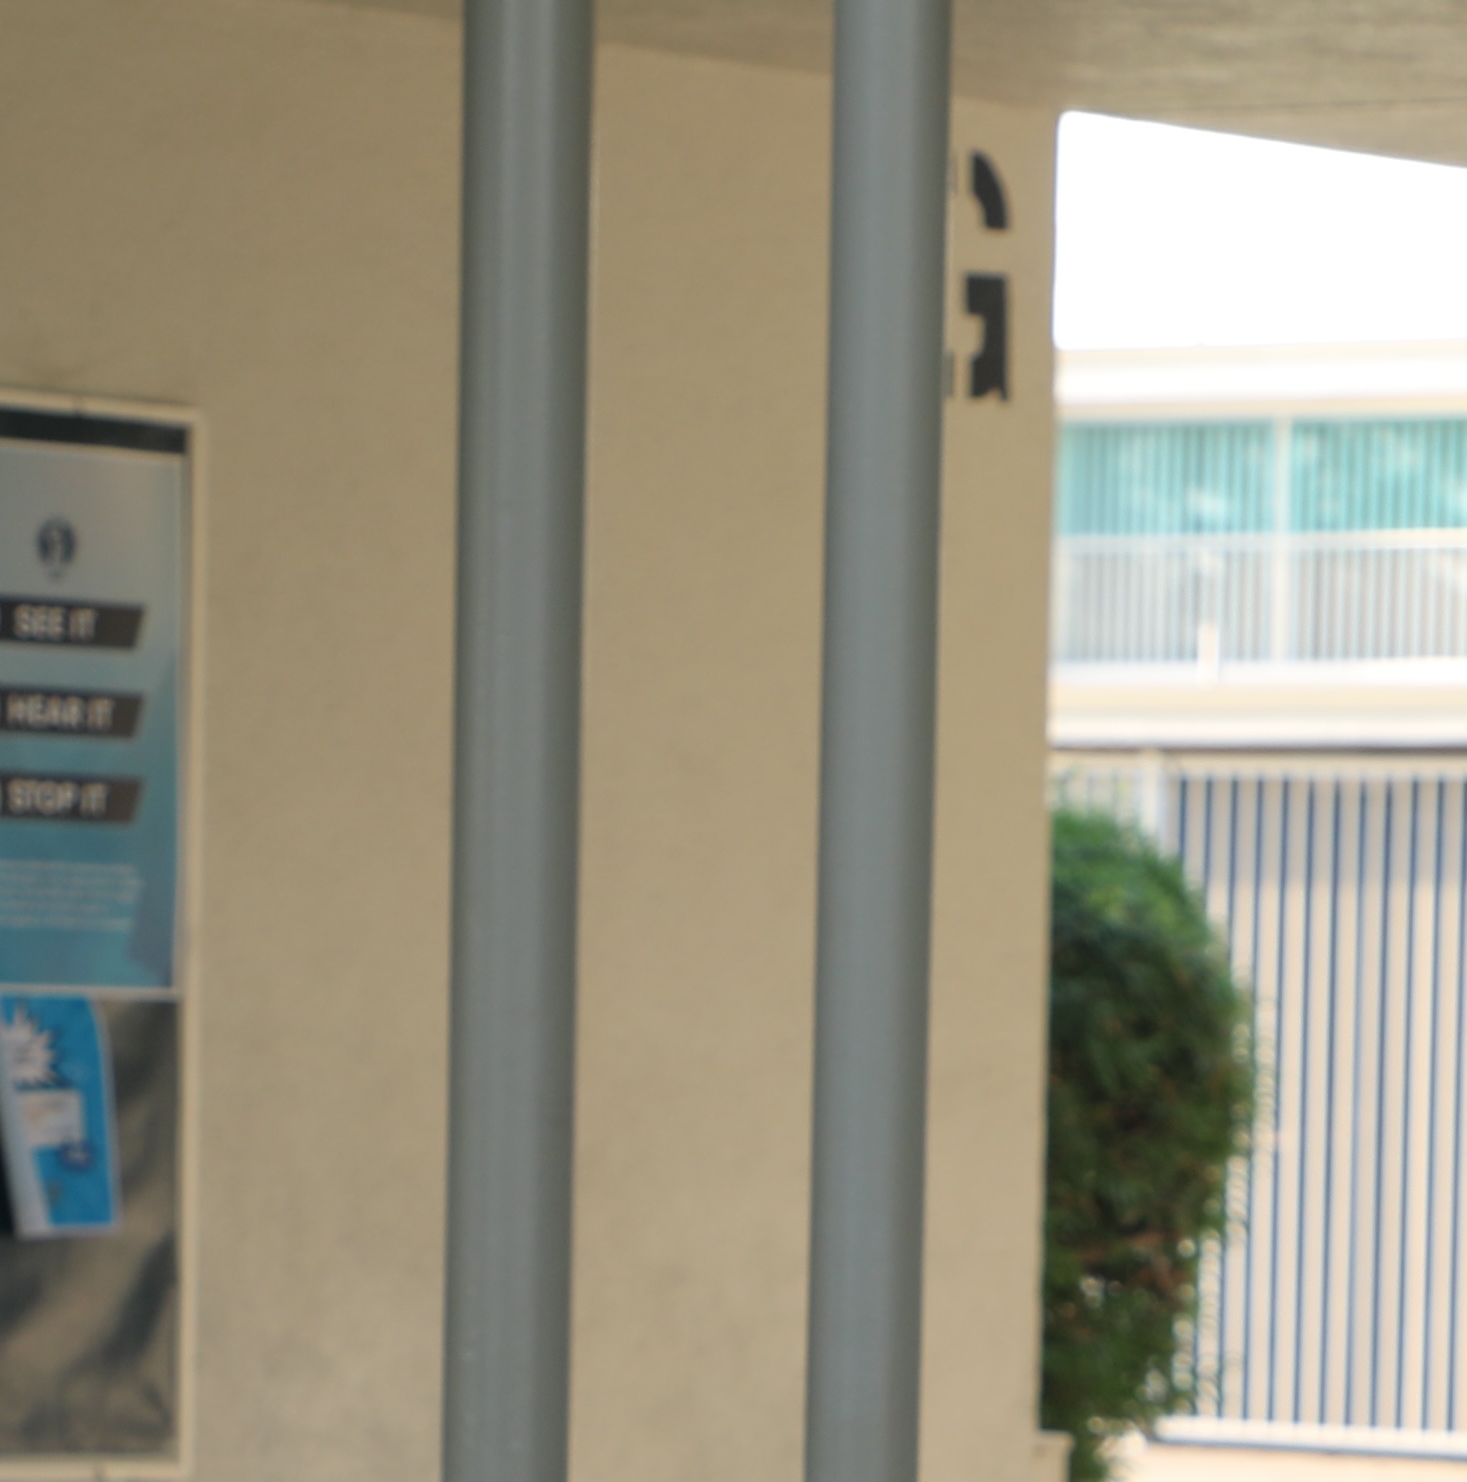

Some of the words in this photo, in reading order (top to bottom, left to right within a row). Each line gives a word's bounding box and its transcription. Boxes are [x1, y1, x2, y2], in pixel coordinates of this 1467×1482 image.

[12, 603, 65, 639] SEE
[69, 608, 99, 641] IT
[6, 693, 80, 731] HEAR
[85, 697, 114, 732] IT
[7, 778, 80, 815] STOP
[80, 782, 109, 817] IT
